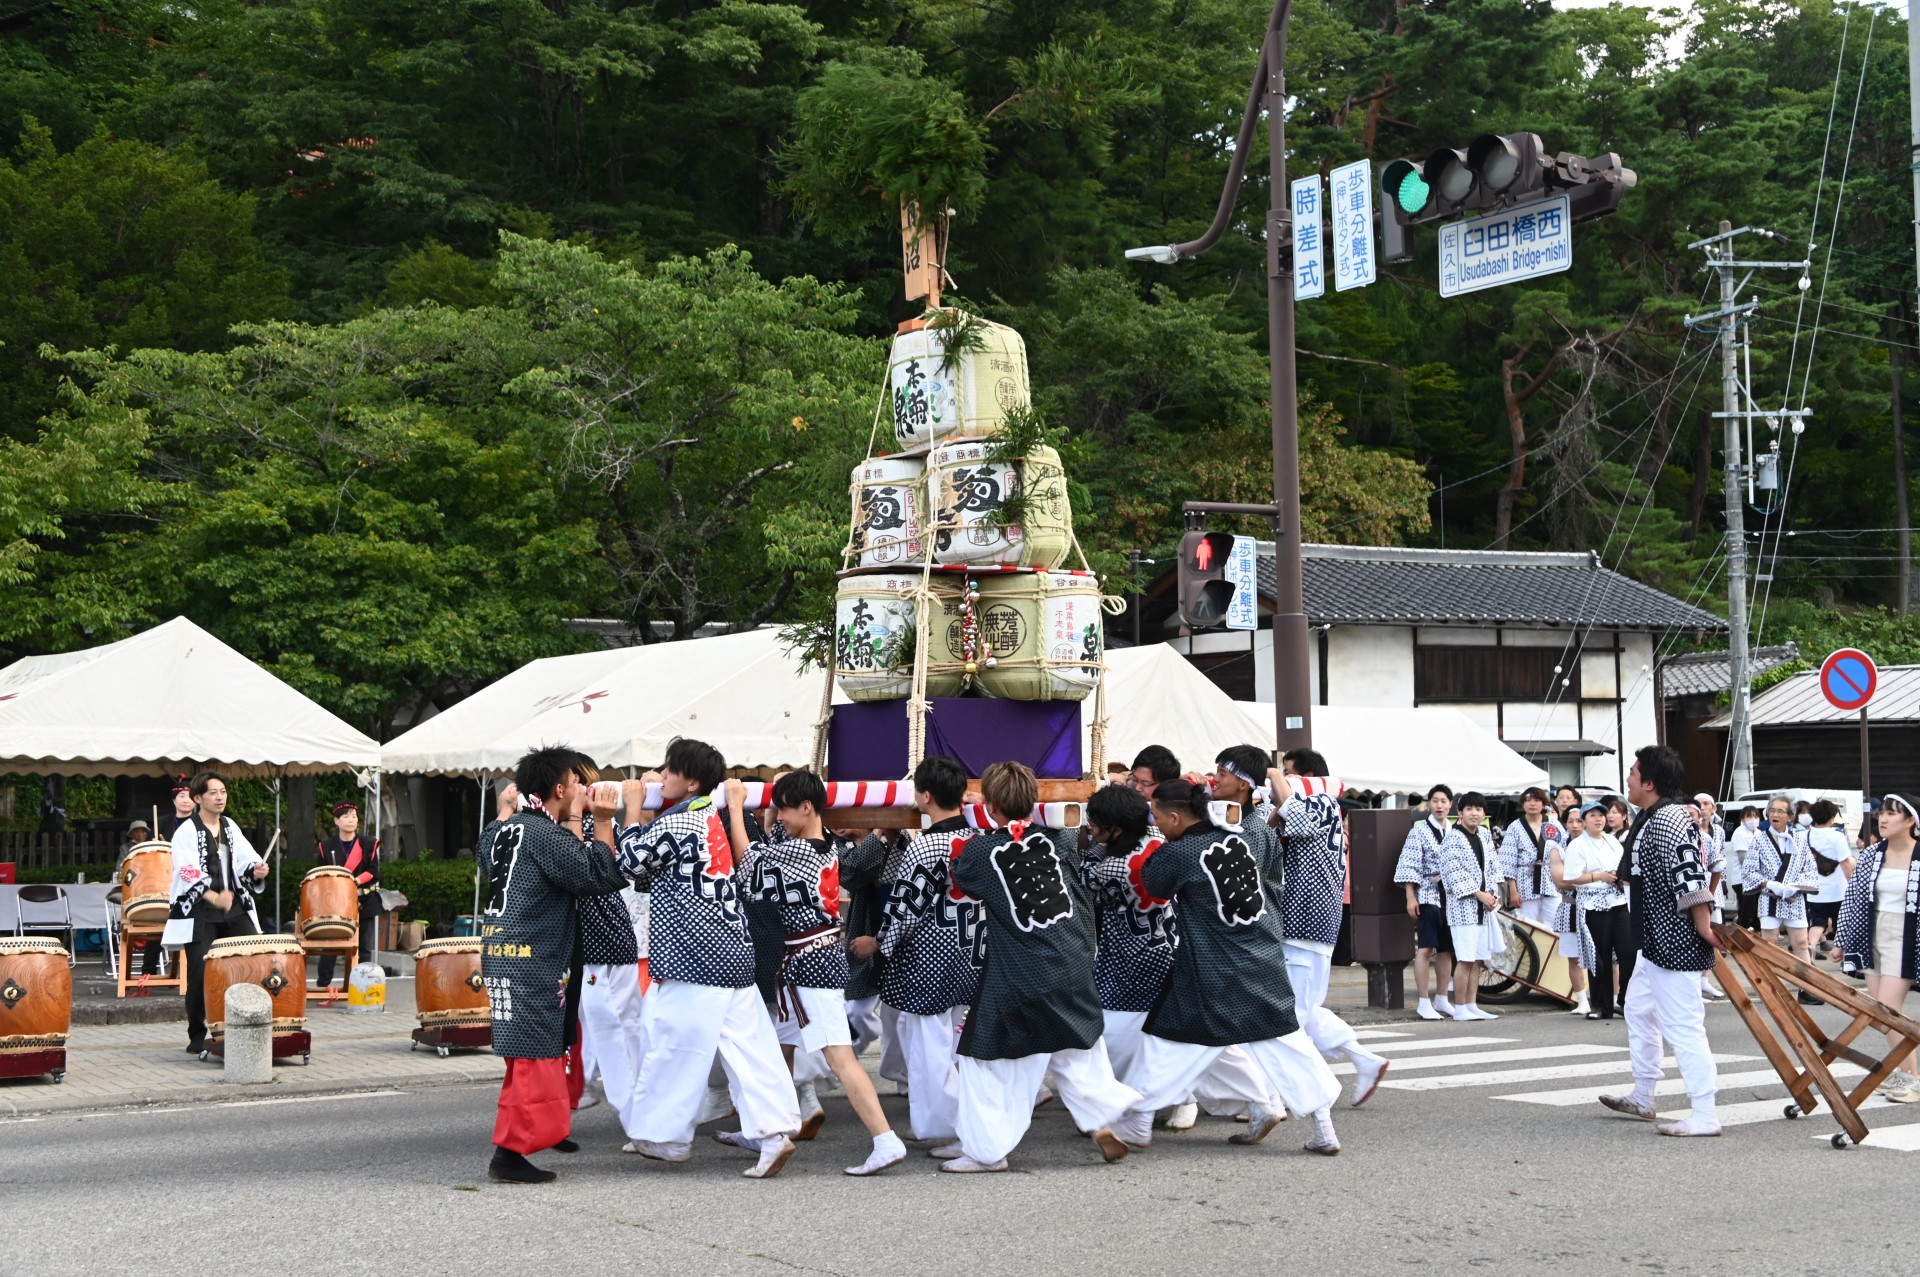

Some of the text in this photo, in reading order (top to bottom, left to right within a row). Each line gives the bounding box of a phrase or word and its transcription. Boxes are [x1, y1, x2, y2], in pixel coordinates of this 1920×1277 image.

[1296, 187, 1319, 289] 時差式
[1348, 168, 1369, 281] 歩車分離式
[1443, 230, 1456, 288] 佐久市
[1463, 206, 1562, 257] 臼田橋西
[1460, 239, 1567, 284] Usudabashi Bridge-nishi
[1229, 546, 1239, 618] (押しボン式)
[1238, 542, 1253, 624] 歩車分離式
